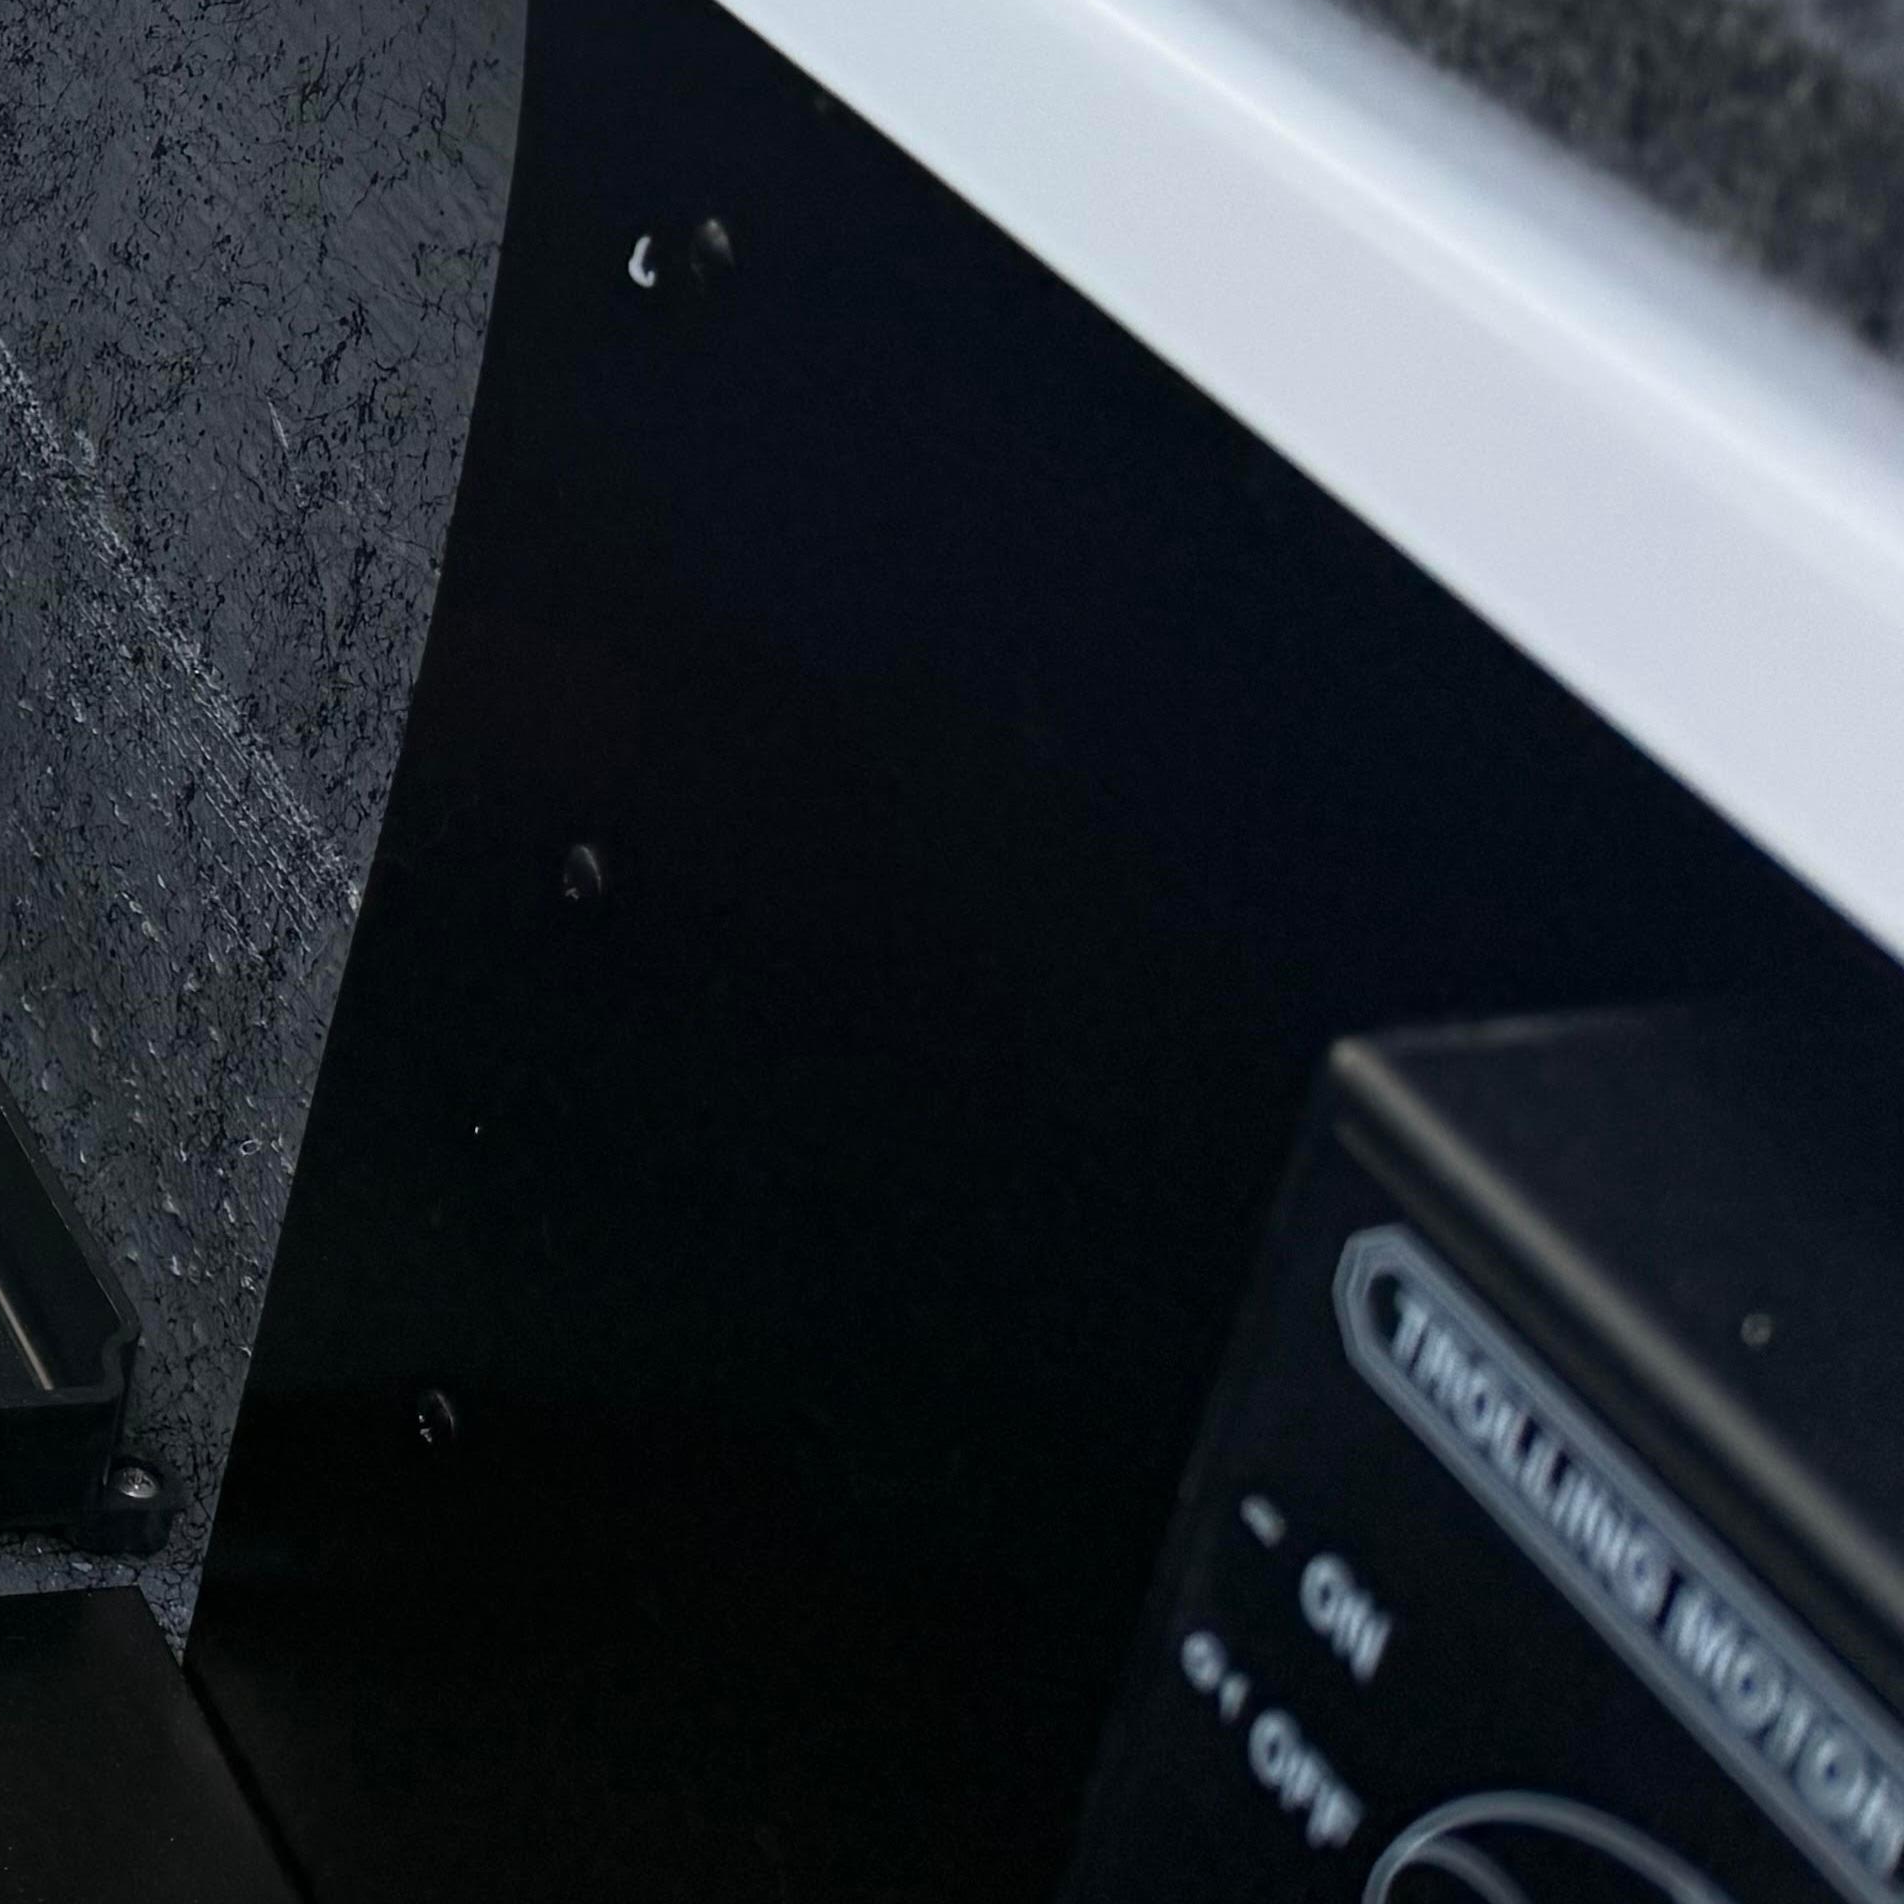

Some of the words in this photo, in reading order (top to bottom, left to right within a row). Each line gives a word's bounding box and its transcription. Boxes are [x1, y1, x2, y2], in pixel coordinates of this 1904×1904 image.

[1390, 1294, 1674, 1614] TROLLING
[1298, 1551, 1393, 1686] ON
[1247, 1706, 1364, 1850] OFF
